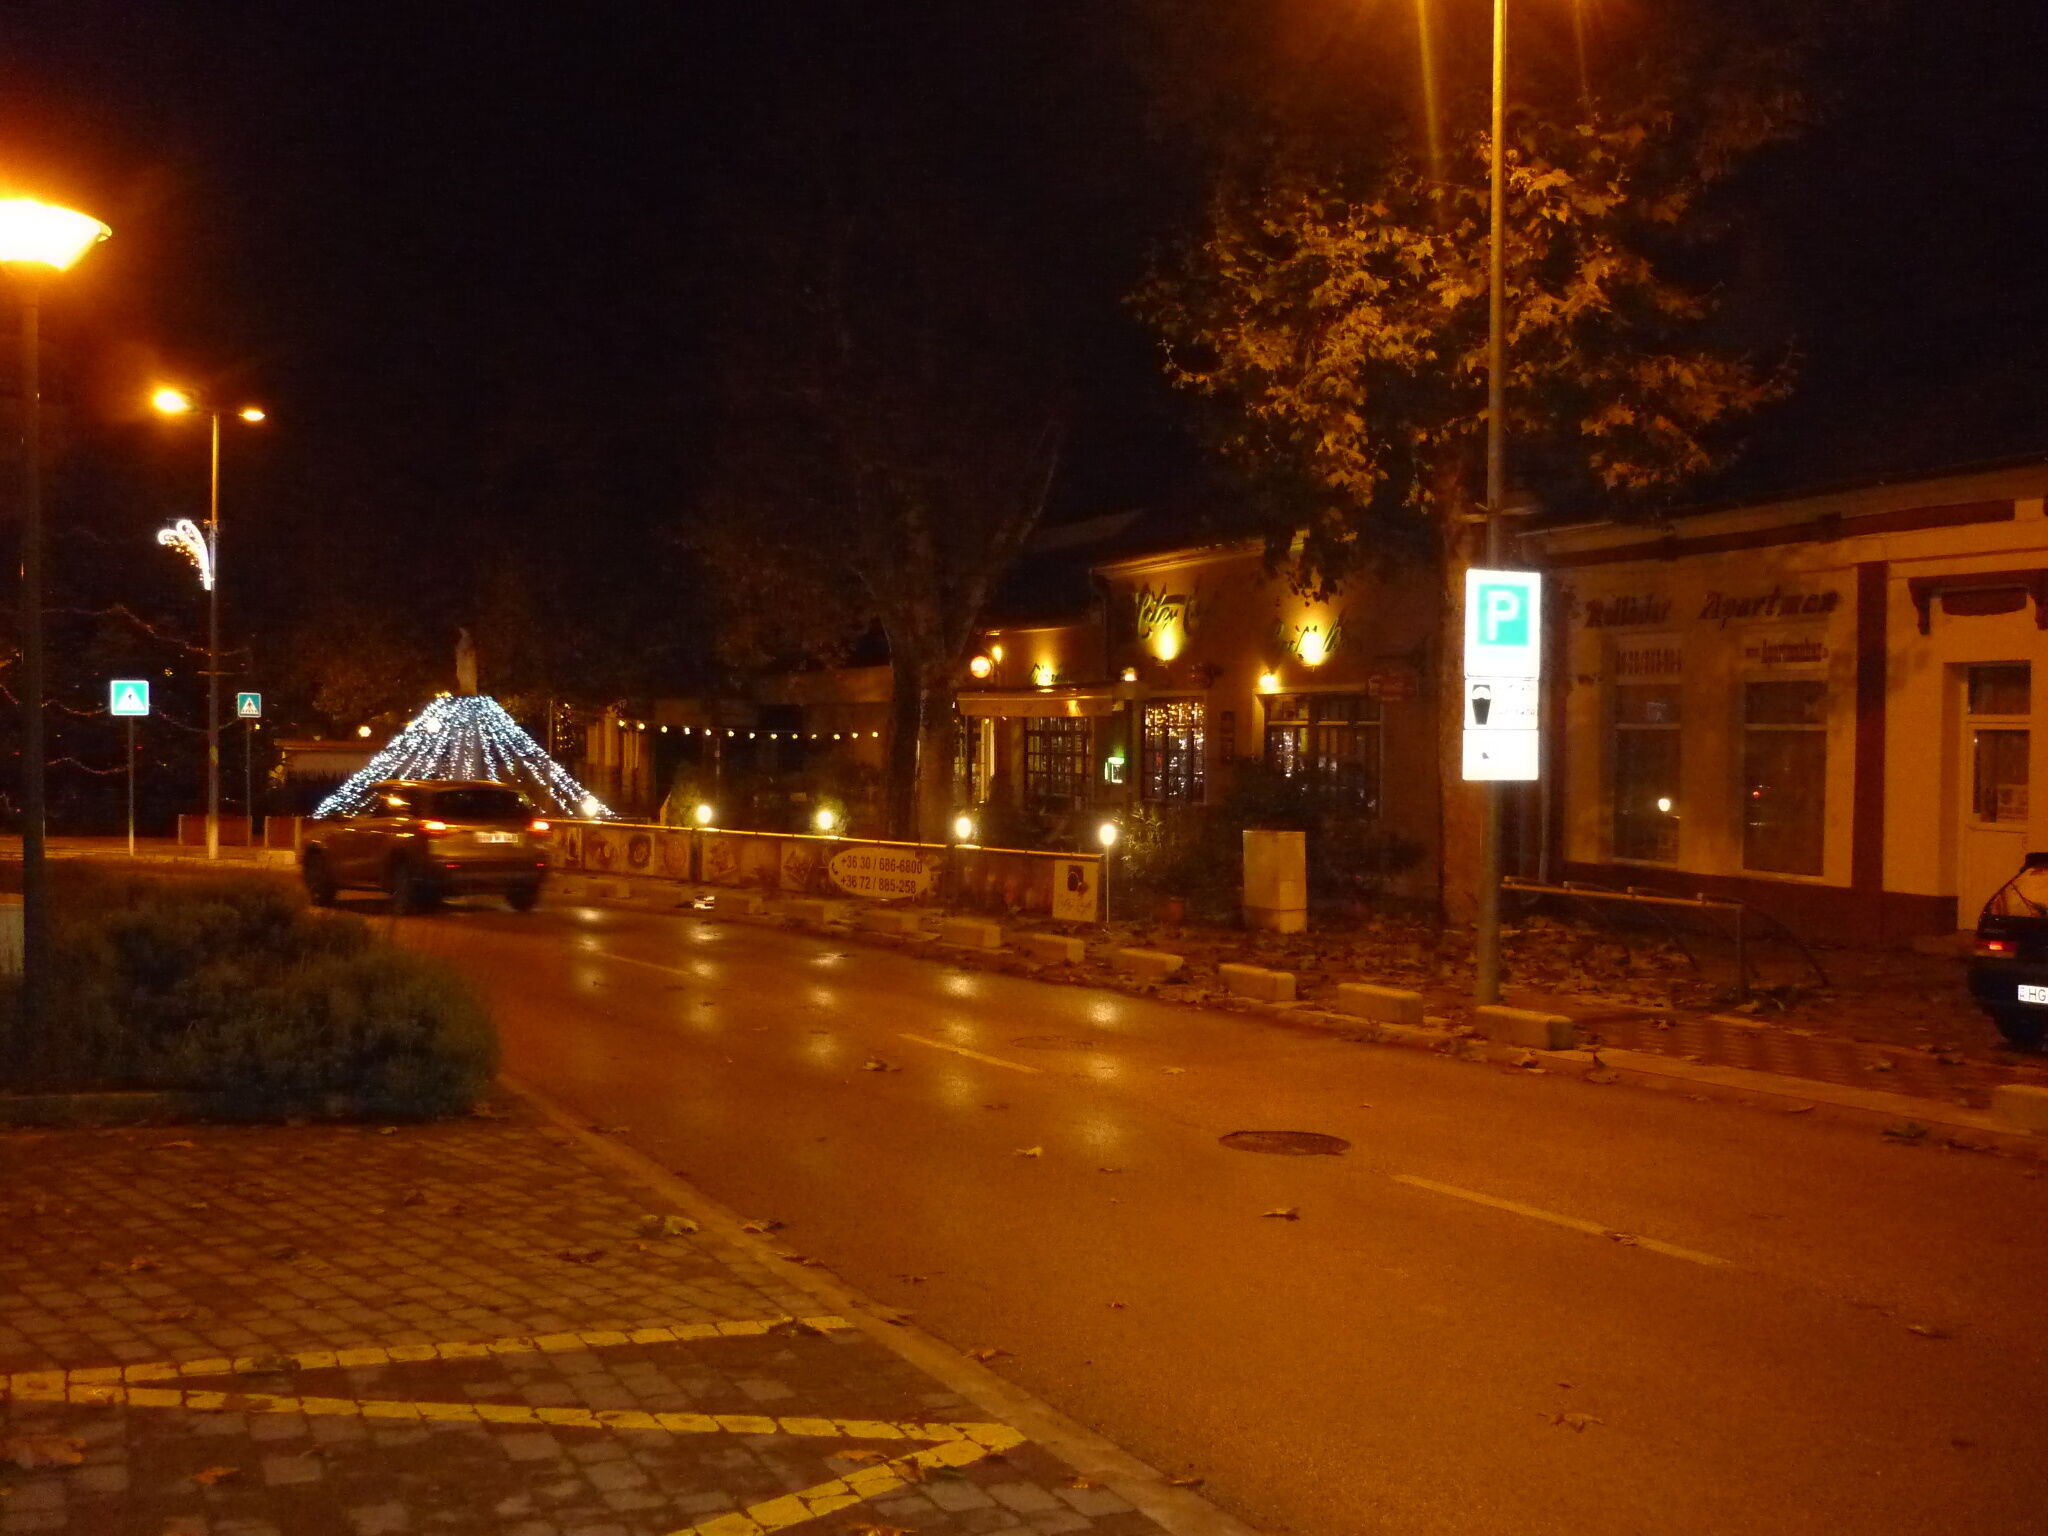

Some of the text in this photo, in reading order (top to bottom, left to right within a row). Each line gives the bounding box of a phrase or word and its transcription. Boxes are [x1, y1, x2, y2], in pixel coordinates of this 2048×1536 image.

[1487, 590, 1520, 641] P
[841, 855, 858, 869] +36
[860, 856, 871, 870] 30
[841, 874, 857, 888] +36
[860, 876, 871, 889] 72
